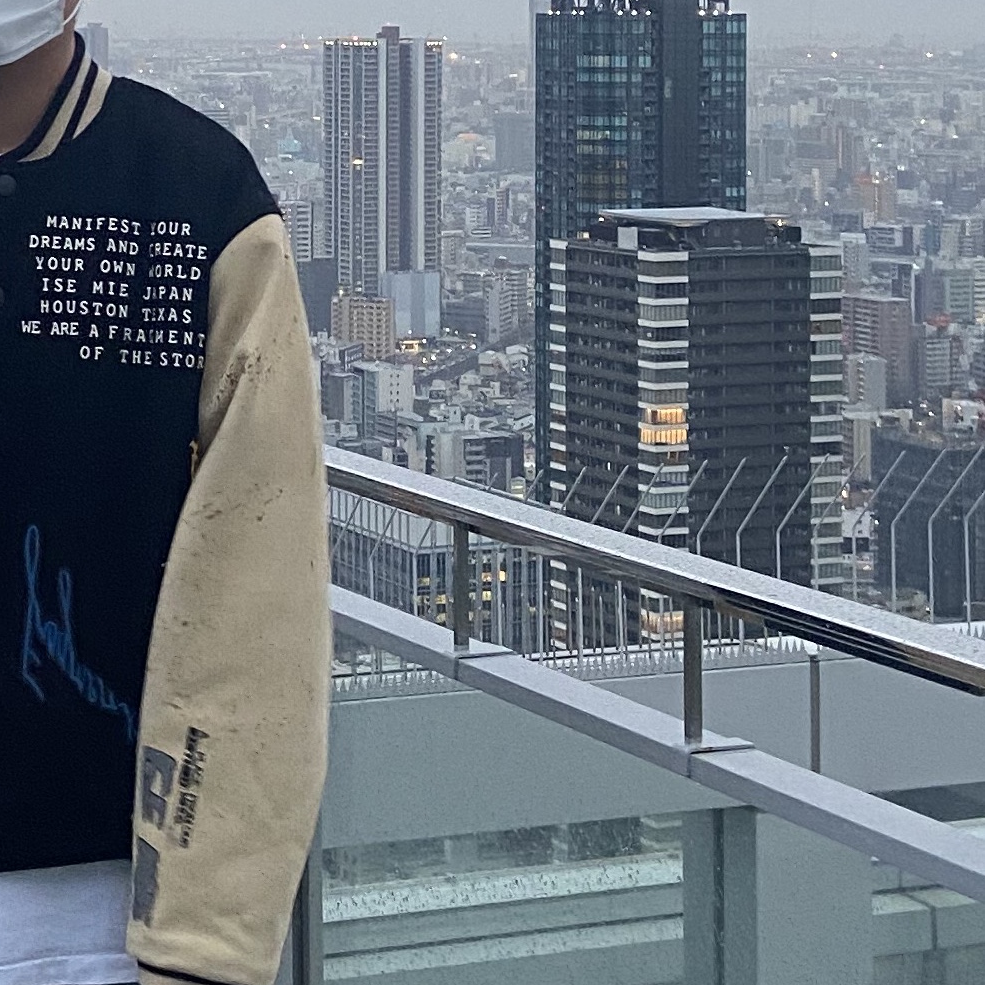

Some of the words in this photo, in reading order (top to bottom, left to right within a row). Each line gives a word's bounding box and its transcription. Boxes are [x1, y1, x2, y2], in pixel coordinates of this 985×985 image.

[46, 215, 142, 236] MANIFEST
[149, 221, 191, 236] YOUR
[28, 234, 96, 252] DREAMS
[106, 238, 139, 256] AND
[35, 255, 85, 272] YOUR
[99, 259, 136, 277] OWN
[42, 277, 77, 293] ISE
[91, 281, 129, 298] MIE
[40, 299, 129, 318] HOUSTON
[21, 320, 42, 335] WE
[49, 321, 80, 336] ARE
[88, 323, 99, 338] A
[79, 345, 105, 361] OF
[119, 349, 153, 366] THE
